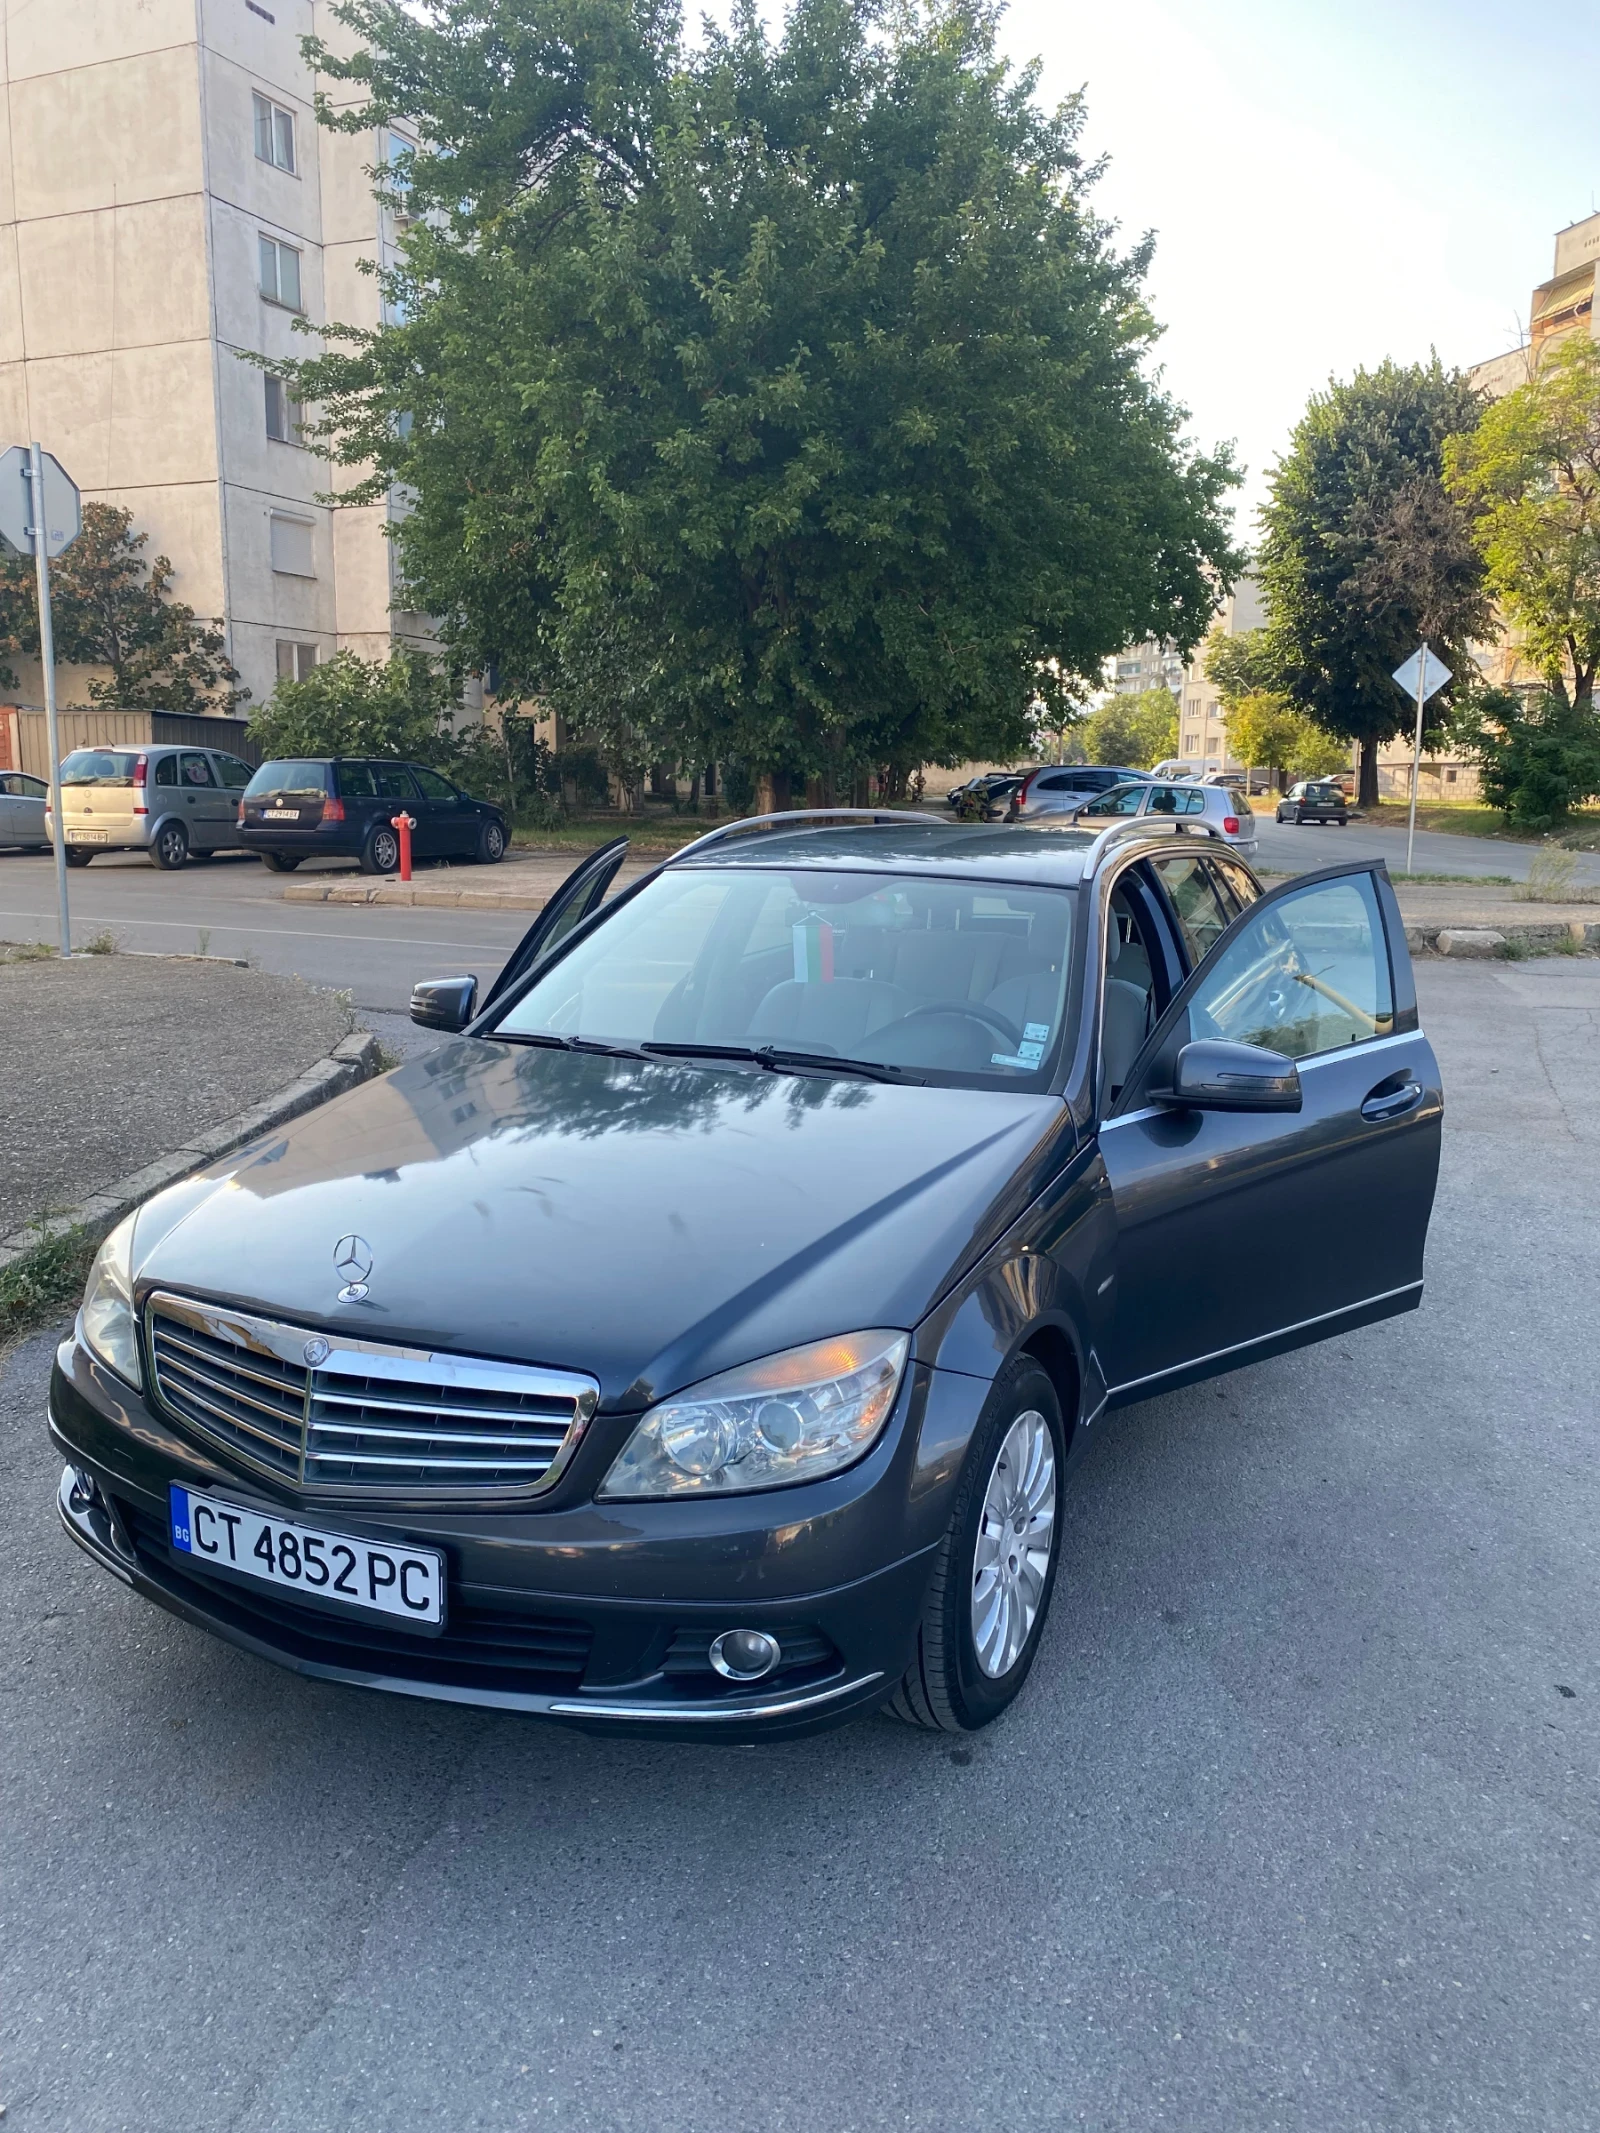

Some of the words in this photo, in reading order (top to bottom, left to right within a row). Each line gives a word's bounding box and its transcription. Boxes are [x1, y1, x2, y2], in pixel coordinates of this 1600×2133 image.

[174, 1524, 190, 1543] BG
[194, 1504, 242, 1562] CT
[253, 1525, 359, 1596] 4852
[368, 1551, 430, 1612] PC
